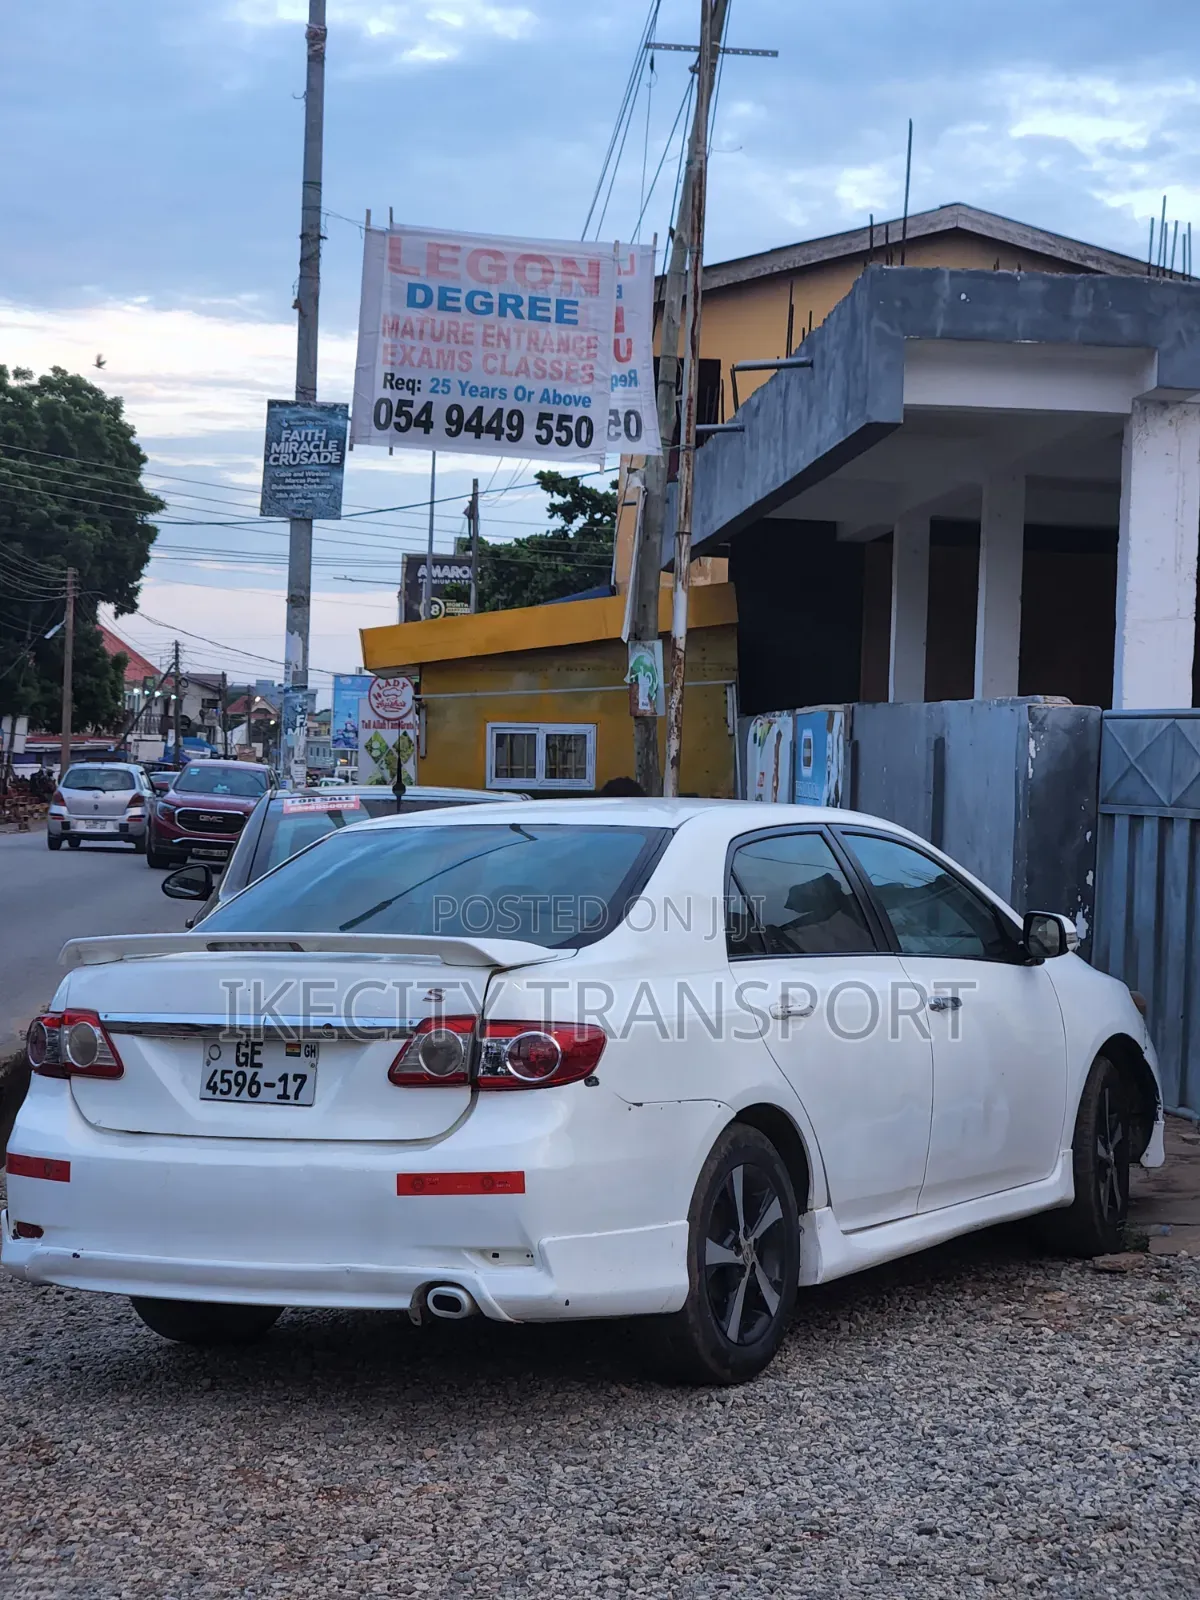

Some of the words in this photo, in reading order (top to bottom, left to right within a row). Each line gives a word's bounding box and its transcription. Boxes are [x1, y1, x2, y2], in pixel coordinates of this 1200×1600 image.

[387, 236, 600, 296] LEGON
[406, 282, 579, 325] DEGREE
[382, 314, 474, 345] MATURE
[482, 324, 598, 359] ENTRANCE
[382, 344, 472, 373] EXAMS
[482, 353, 595, 384] CLASSES
[383, 372, 421, 393] Req:
[429, 377, 451, 395] 25
[457, 380, 508, 400] Years
[514, 384, 535, 401] Or
[539, 387, 592, 408] Above
[281, 429, 327, 441] FAITH
[373, 398, 434, 435] 054
[445, 404, 524, 443] 9449
[534, 411, 594, 449] 550
[268, 451, 342, 466] CRUSADE
[271, 440, 338, 454] MIRACLE
[417, 564, 472, 579] AMARO
[376, 679, 409, 691] LADY
[199, 814, 223, 823] GMC
[236, 1041, 263, 1069] GE
[304, 1044, 316, 1058] GH
[205, 1069, 308, 1101] 4596-17
